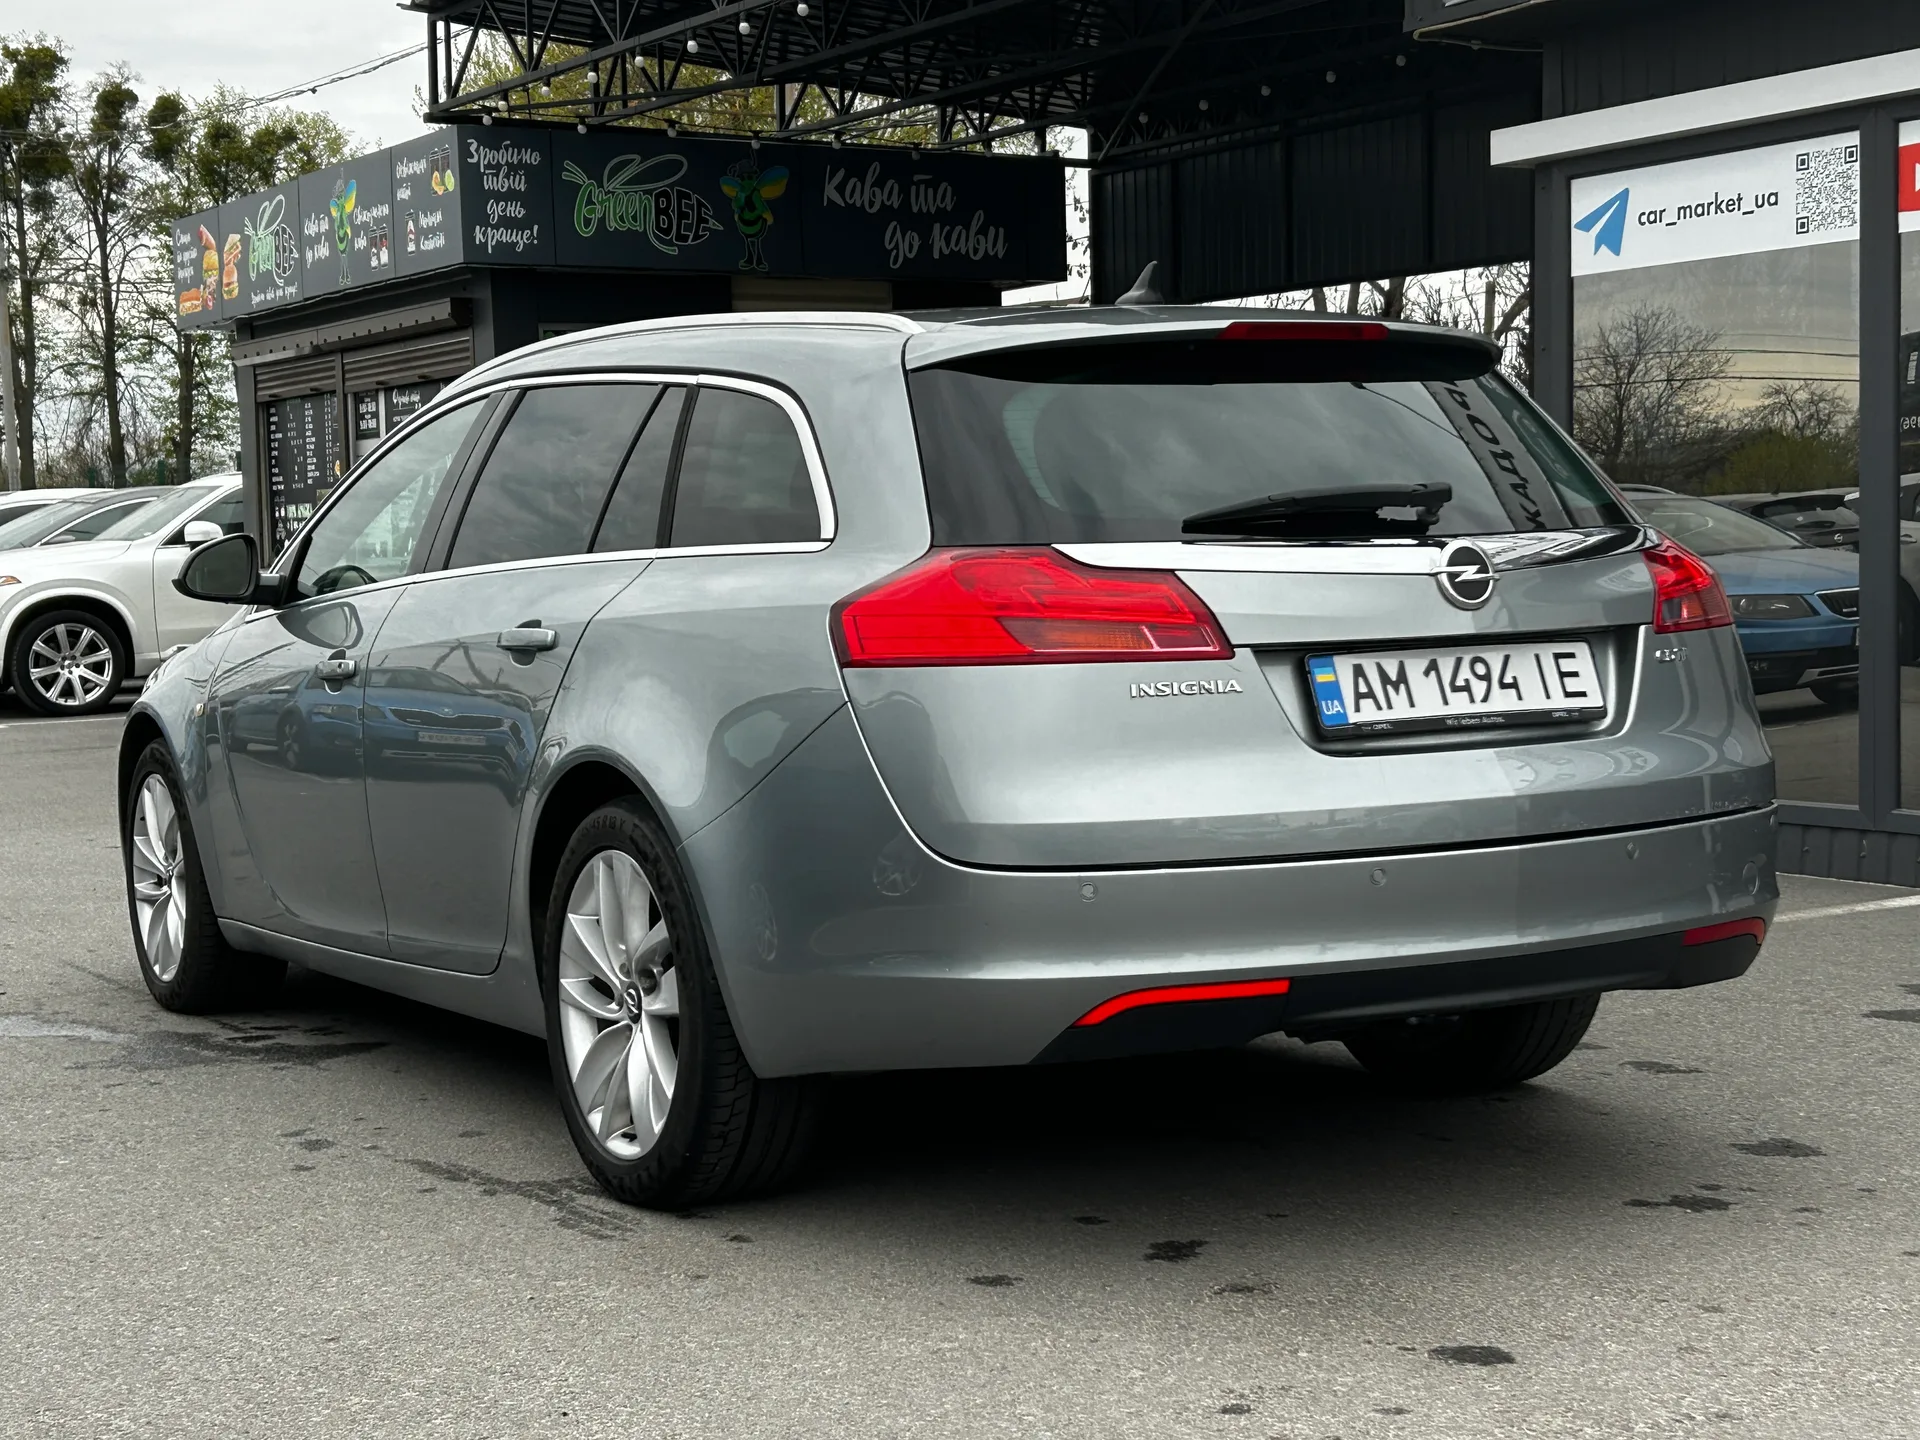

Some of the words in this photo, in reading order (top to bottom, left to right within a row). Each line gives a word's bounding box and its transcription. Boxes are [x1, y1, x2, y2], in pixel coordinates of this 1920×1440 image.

[466, 138, 541, 172] Зробимо
[483, 166, 527, 192] твій
[823, 161, 902, 214] Кава
[910, 174, 956, 214] та
[486, 199, 526, 224] день
[1638, 192, 1779, 227] car_market_ua
[473, 224, 539, 254] краще!
[884, 220, 921, 269] до
[930, 209, 1008, 261] кави
[1130, 679, 1243, 698] INSIGNIA
[1352, 659, 1416, 713] AM
[1423, 653, 1523, 707] 1494
[1534, 651, 1588, 700] IE
[1322, 699, 1344, 716] UA
